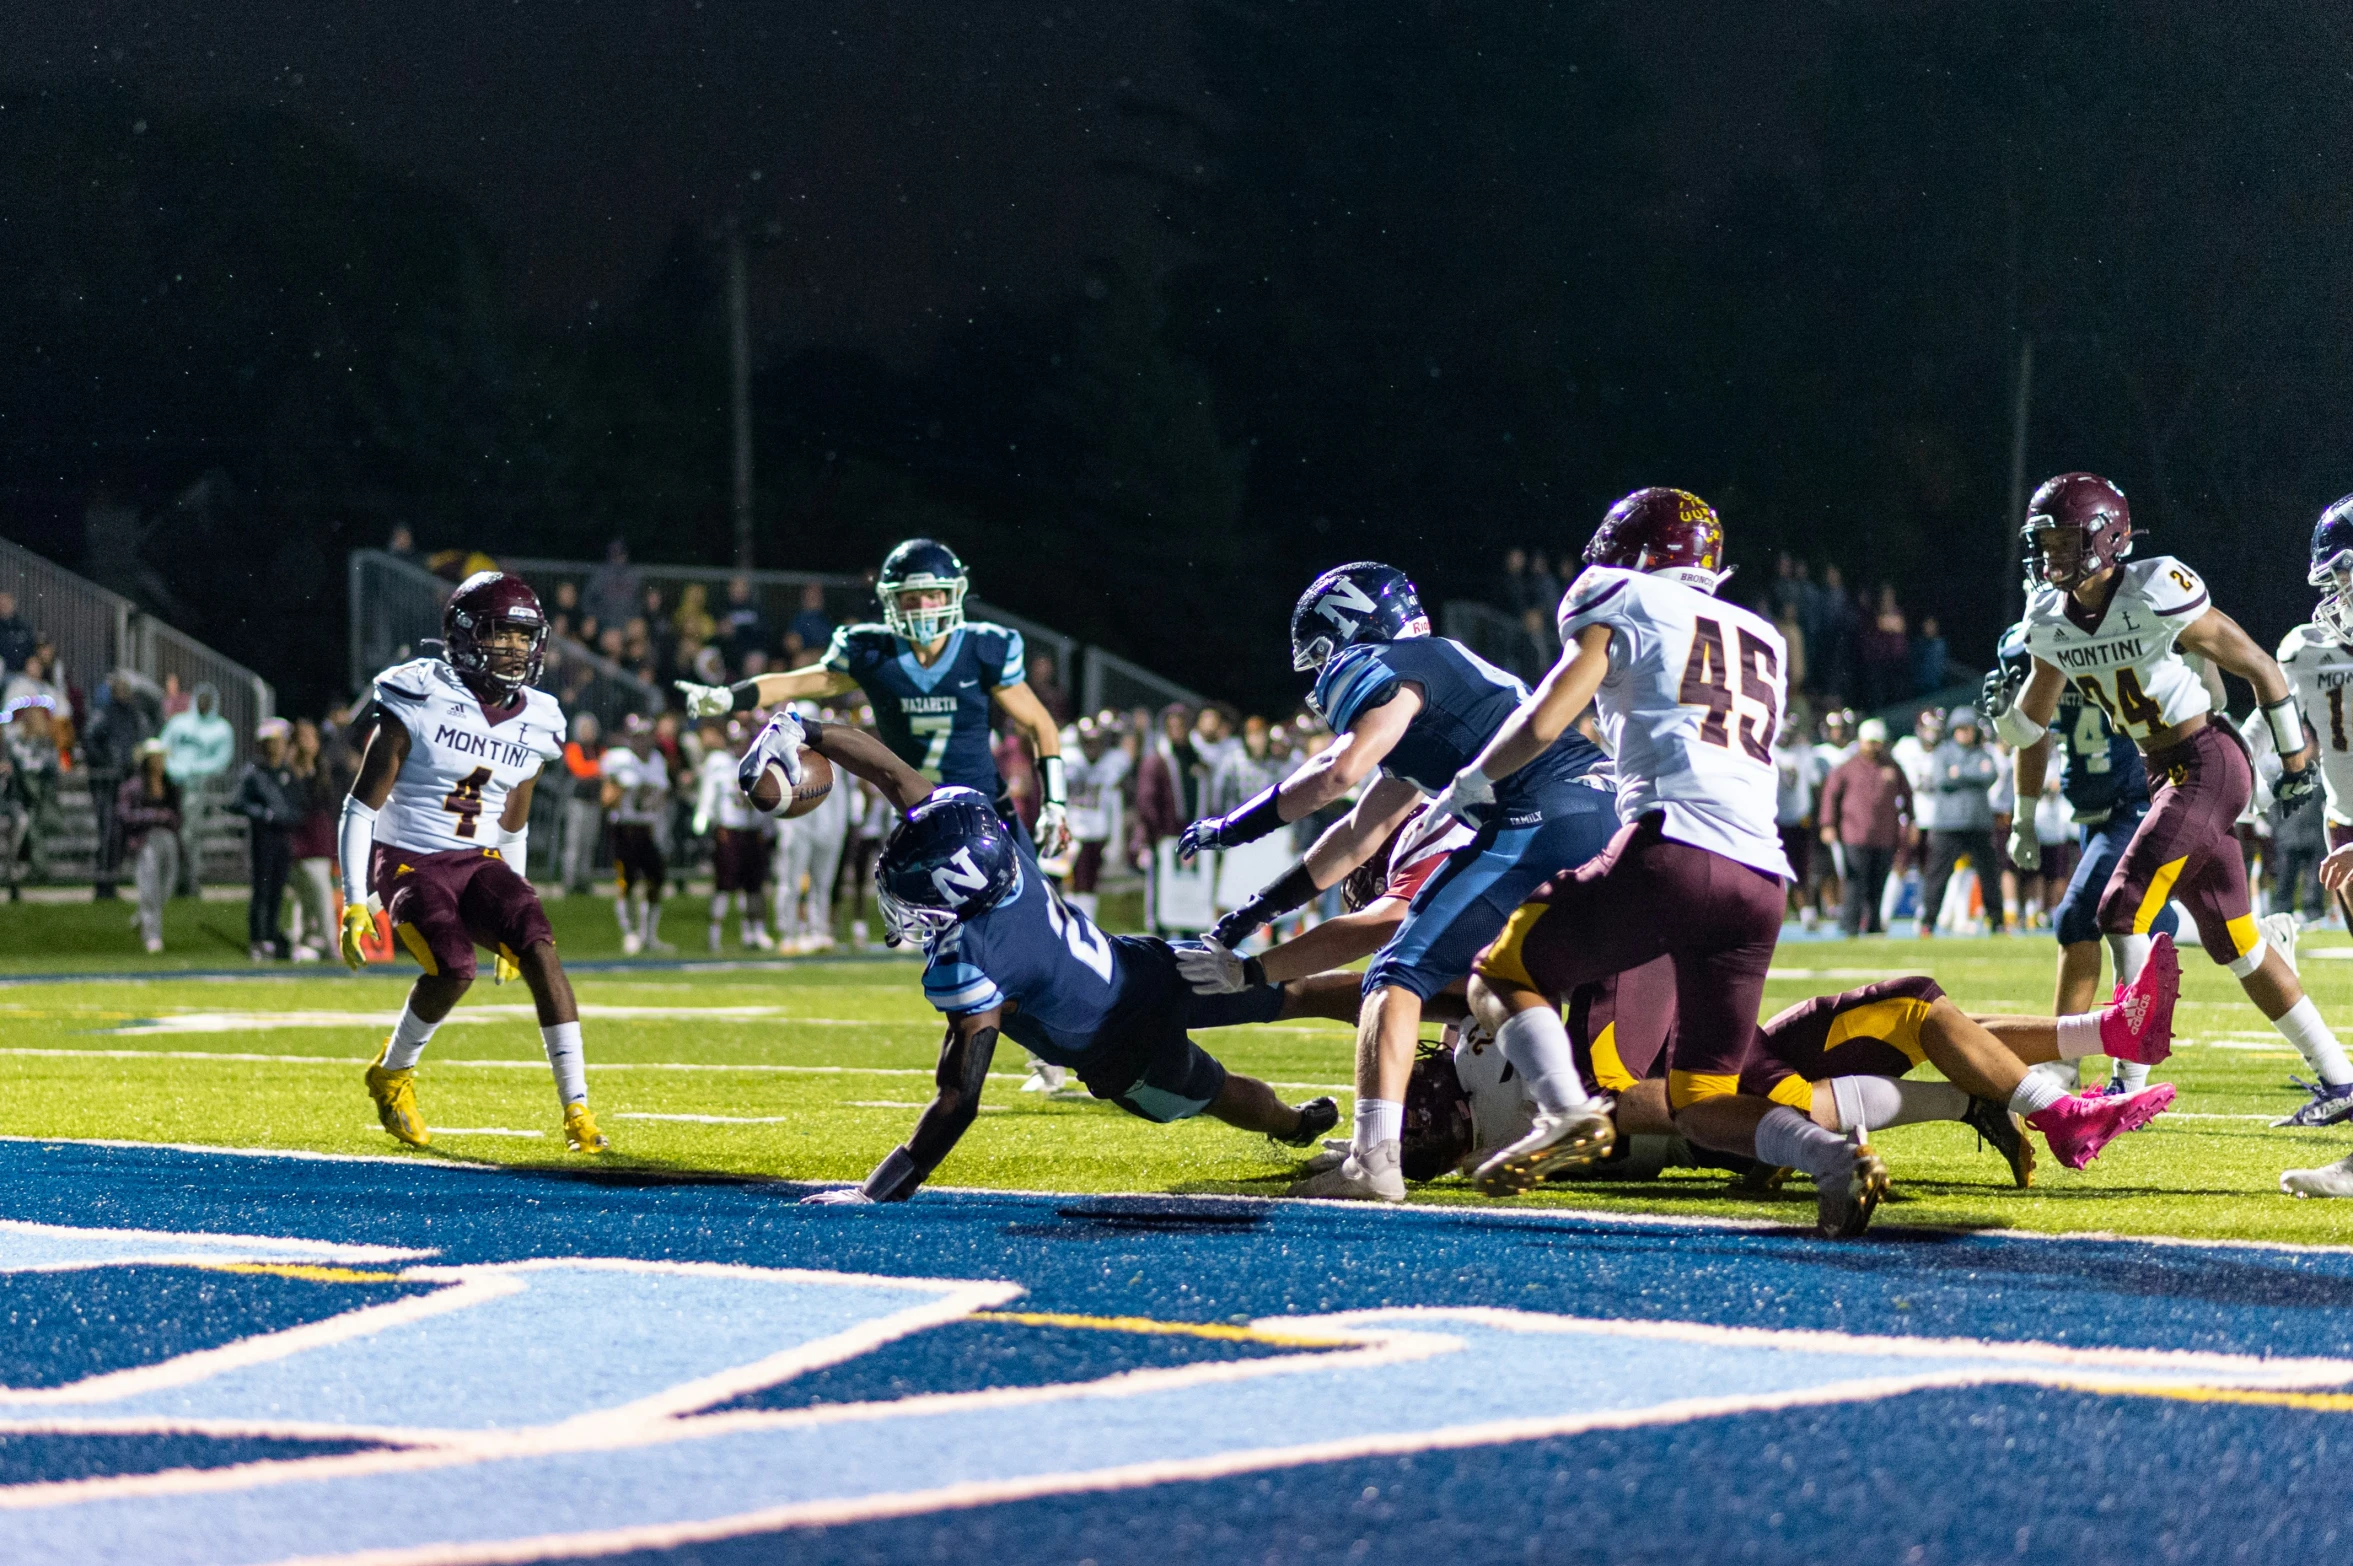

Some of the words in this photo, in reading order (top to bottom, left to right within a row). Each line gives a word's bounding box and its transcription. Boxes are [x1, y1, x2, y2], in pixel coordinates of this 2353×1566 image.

[1314, 575, 1377, 639] N
[2057, 638, 2143, 668] MONTINI
[900, 696, 957, 713] NAZARETH
[1678, 615, 1777, 766] 45
[2076, 666, 2171, 735] 24
[434, 724, 529, 768] MONTINI
[910, 715, 953, 783] 7
[443, 765, 492, 838] 4
[1509, 810, 1543, 825] FAMILY
[931, 845, 989, 908] N
[1041, 879, 1113, 985] 2
[2130, 993, 2151, 1035] adidas
